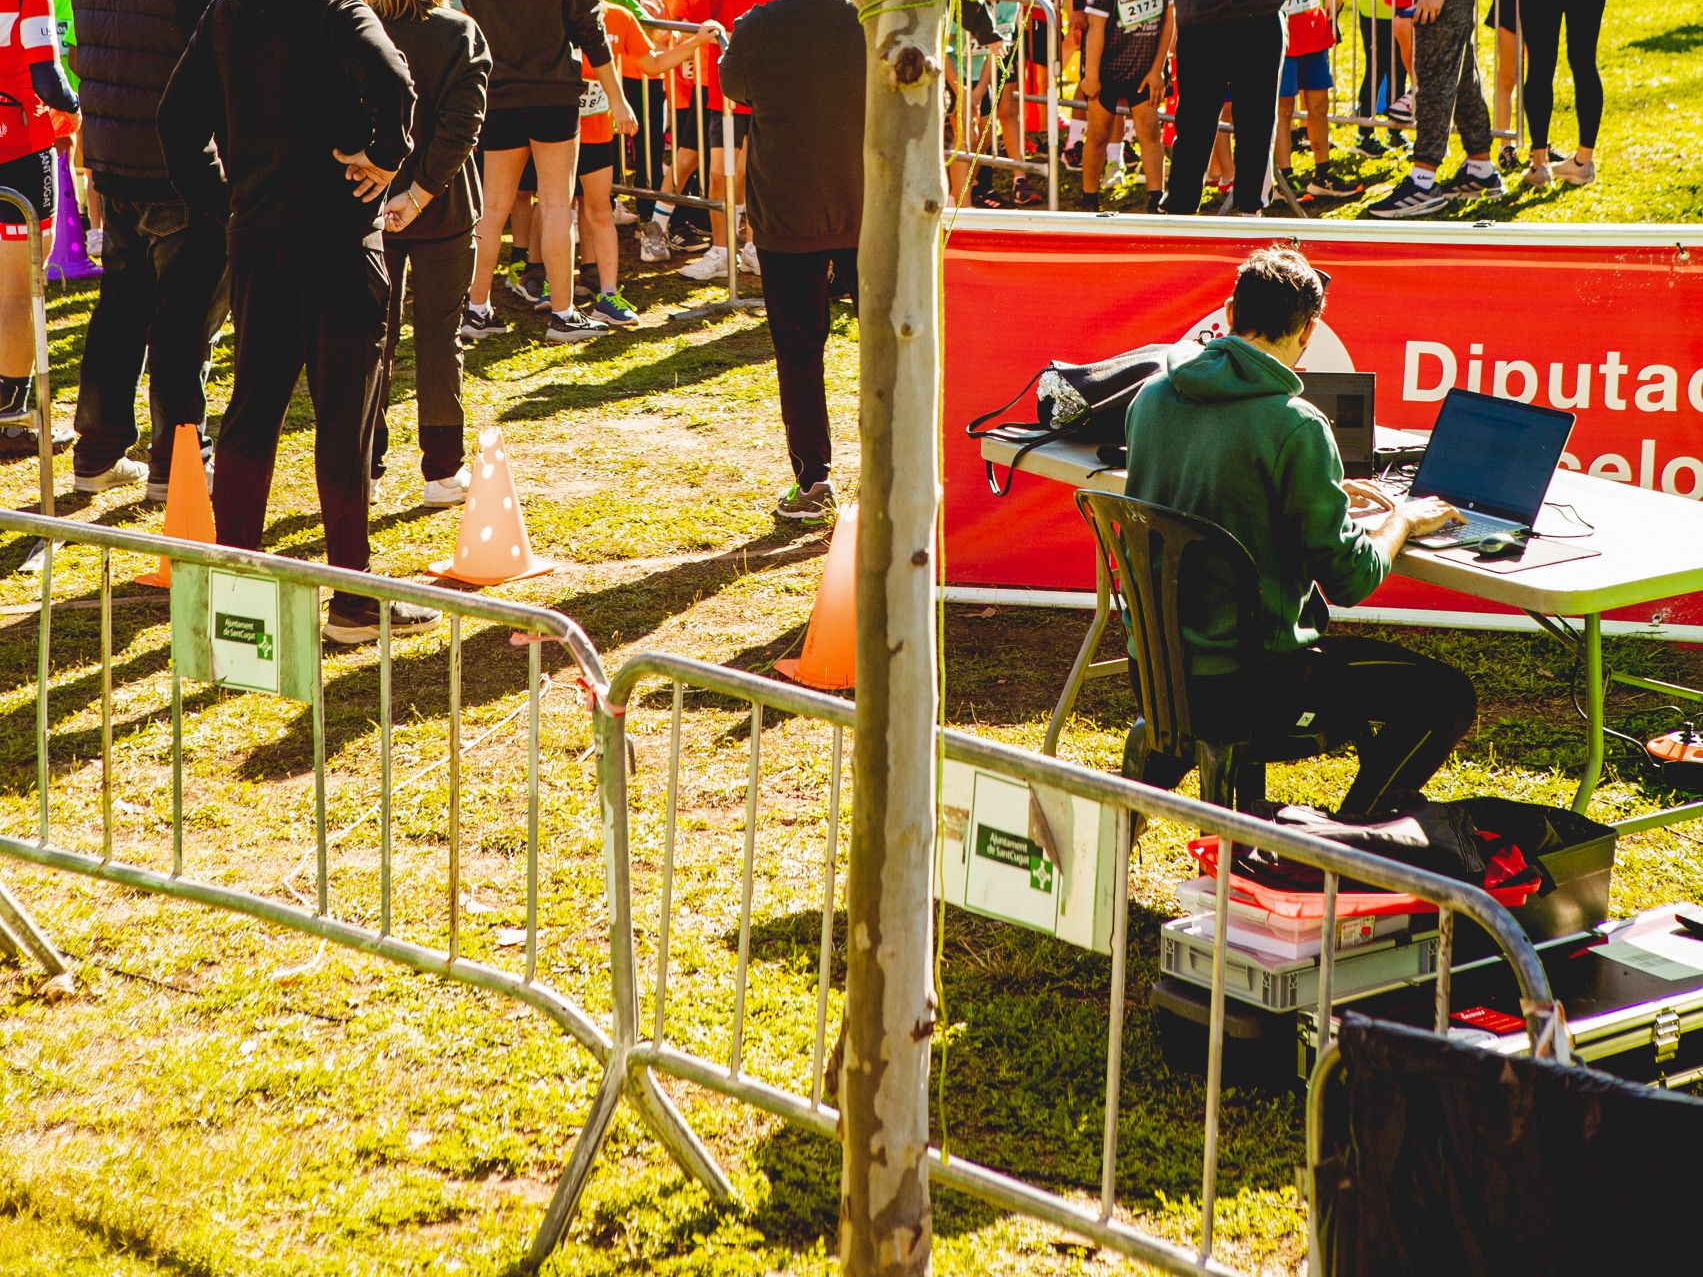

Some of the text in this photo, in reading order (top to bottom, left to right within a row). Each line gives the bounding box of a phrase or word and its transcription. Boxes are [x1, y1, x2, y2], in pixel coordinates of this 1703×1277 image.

[42, 175, 52, 208] CUGAT
[987, 844, 996, 856] de
[990, 832, 1028, 853] Ajuntament
